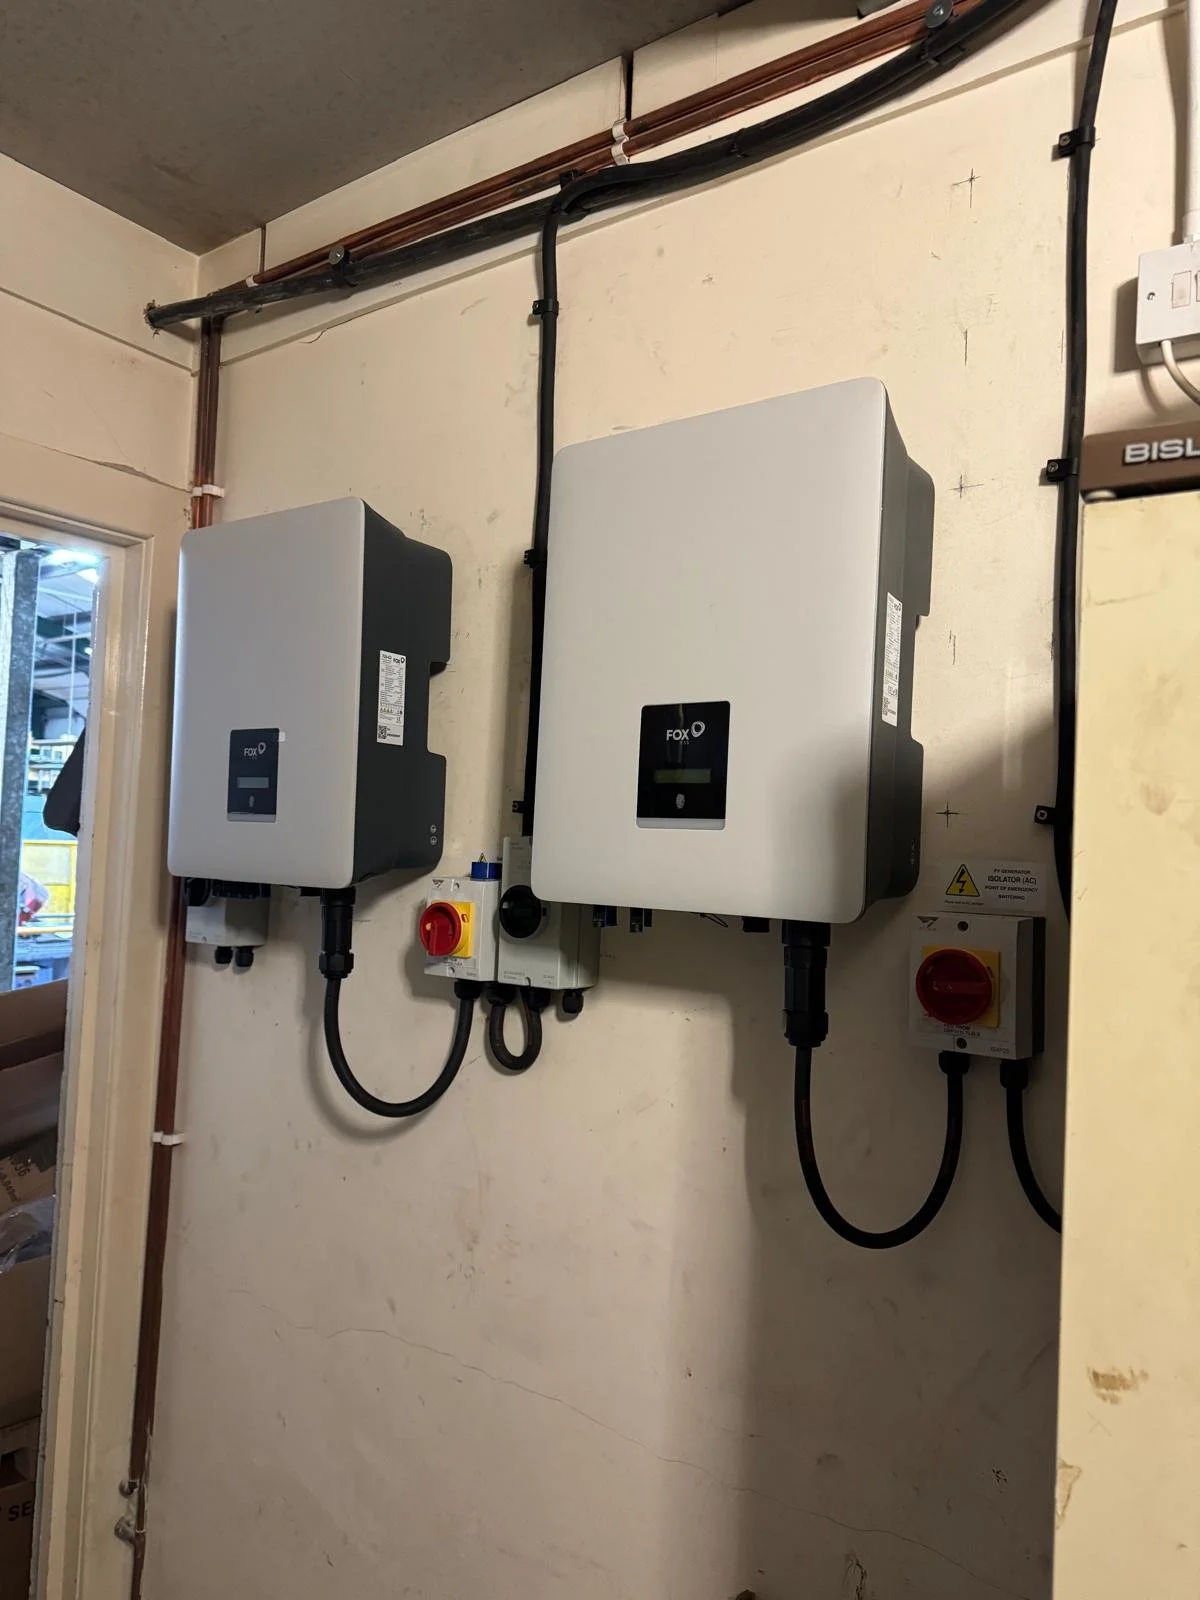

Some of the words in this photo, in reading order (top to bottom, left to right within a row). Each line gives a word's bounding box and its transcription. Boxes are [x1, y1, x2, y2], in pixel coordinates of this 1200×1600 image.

[666, 729, 690, 741] FOX
[243, 747, 257, 756] FOX
[1022, 877, 1037, 885] (AC)
